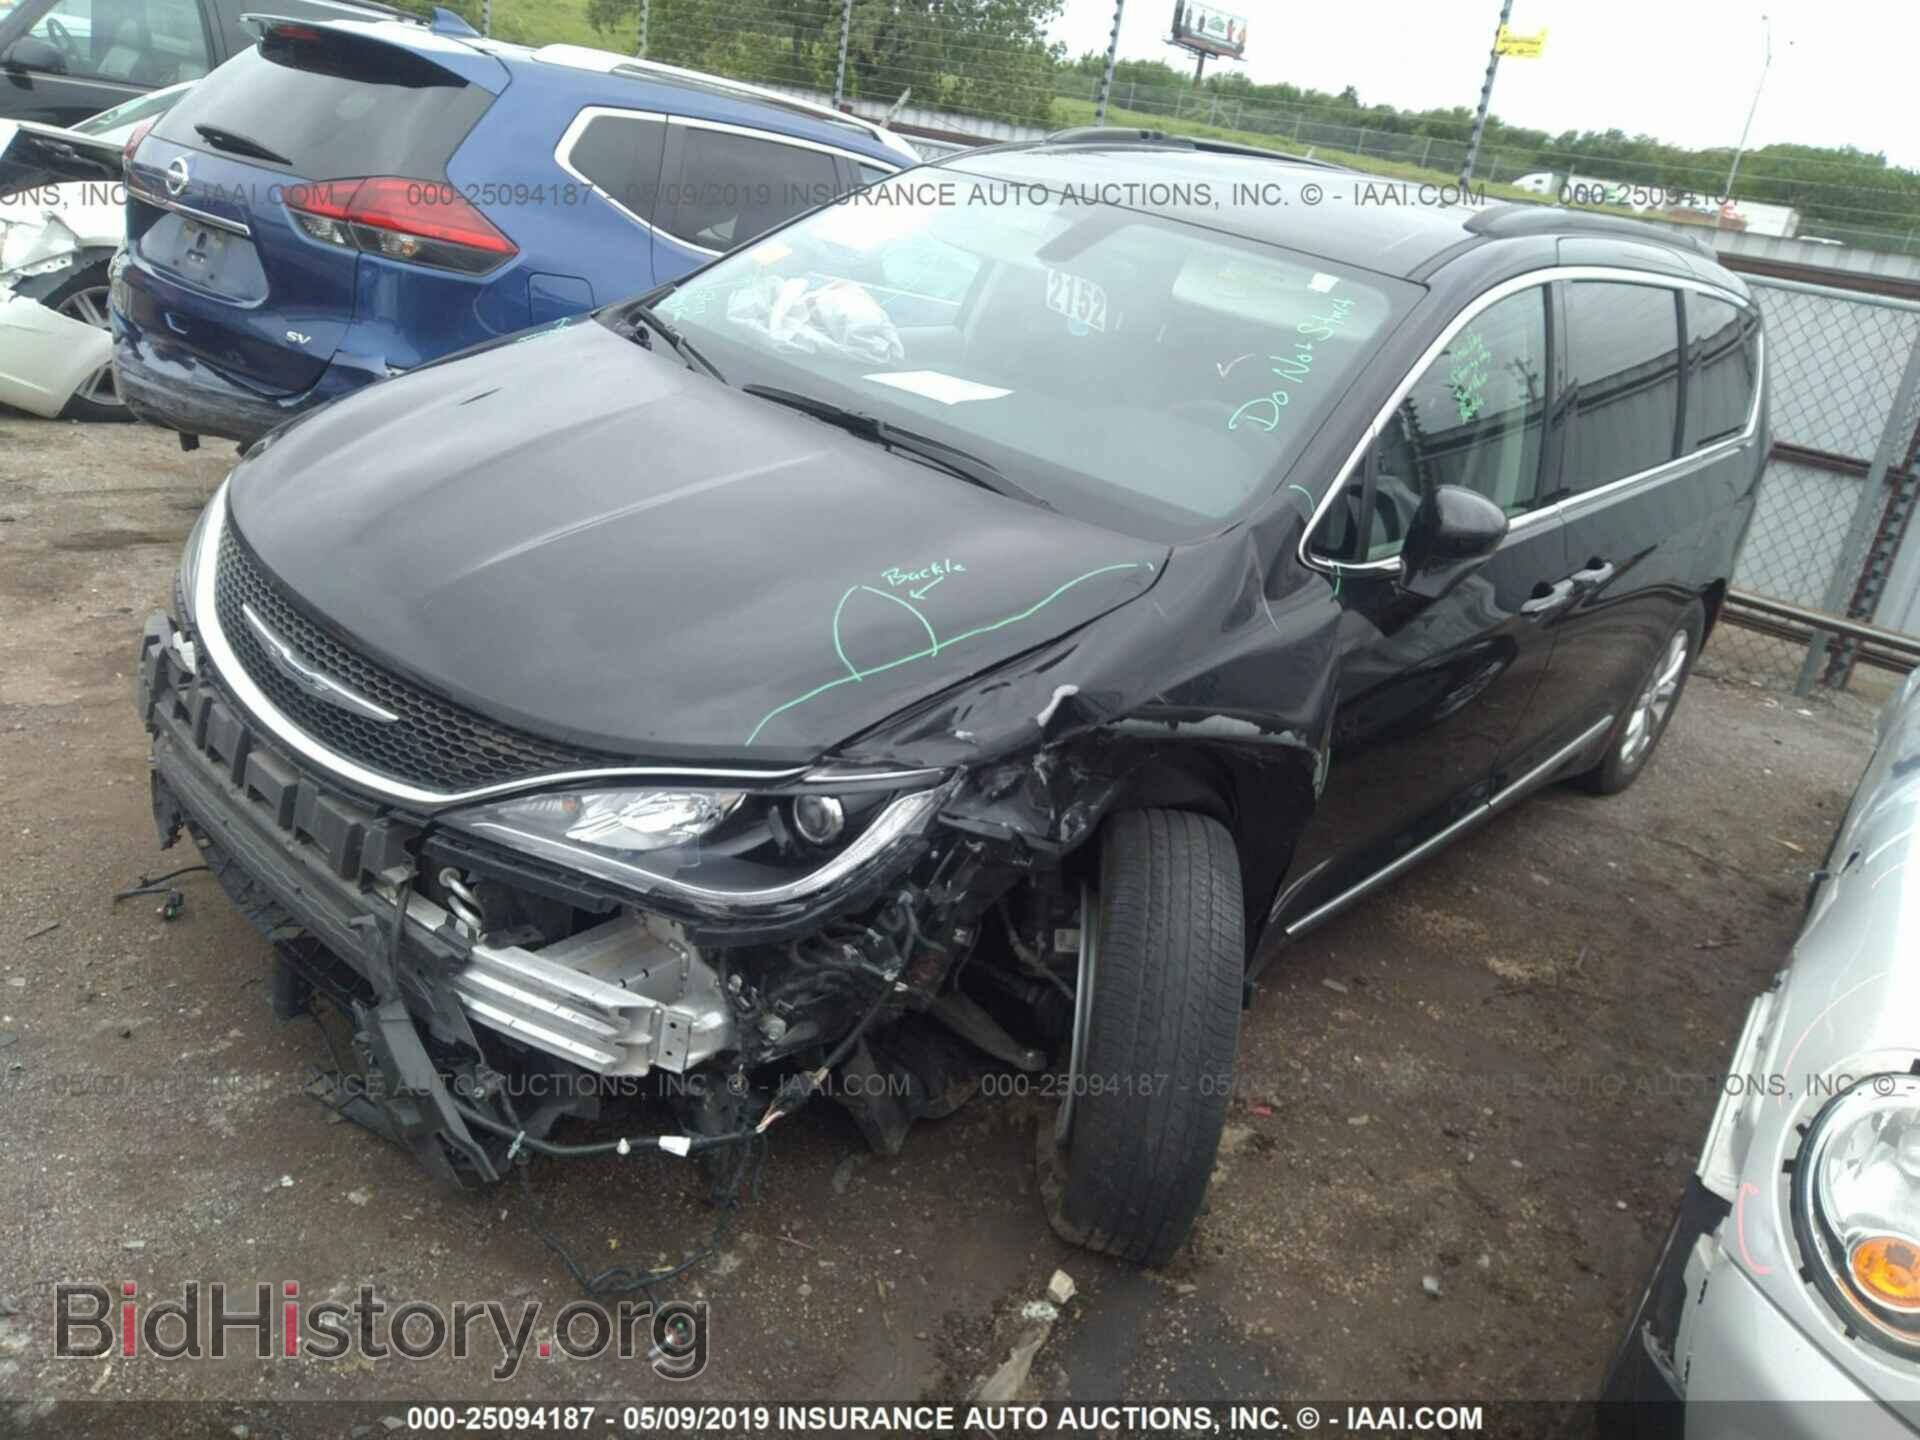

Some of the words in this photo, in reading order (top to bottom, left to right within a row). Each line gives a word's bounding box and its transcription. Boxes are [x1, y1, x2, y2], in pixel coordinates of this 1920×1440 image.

[286, 331, 312, 343] SV
[1229, 391, 1289, 431] Do
[1269, 344, 1313, 383] Not
